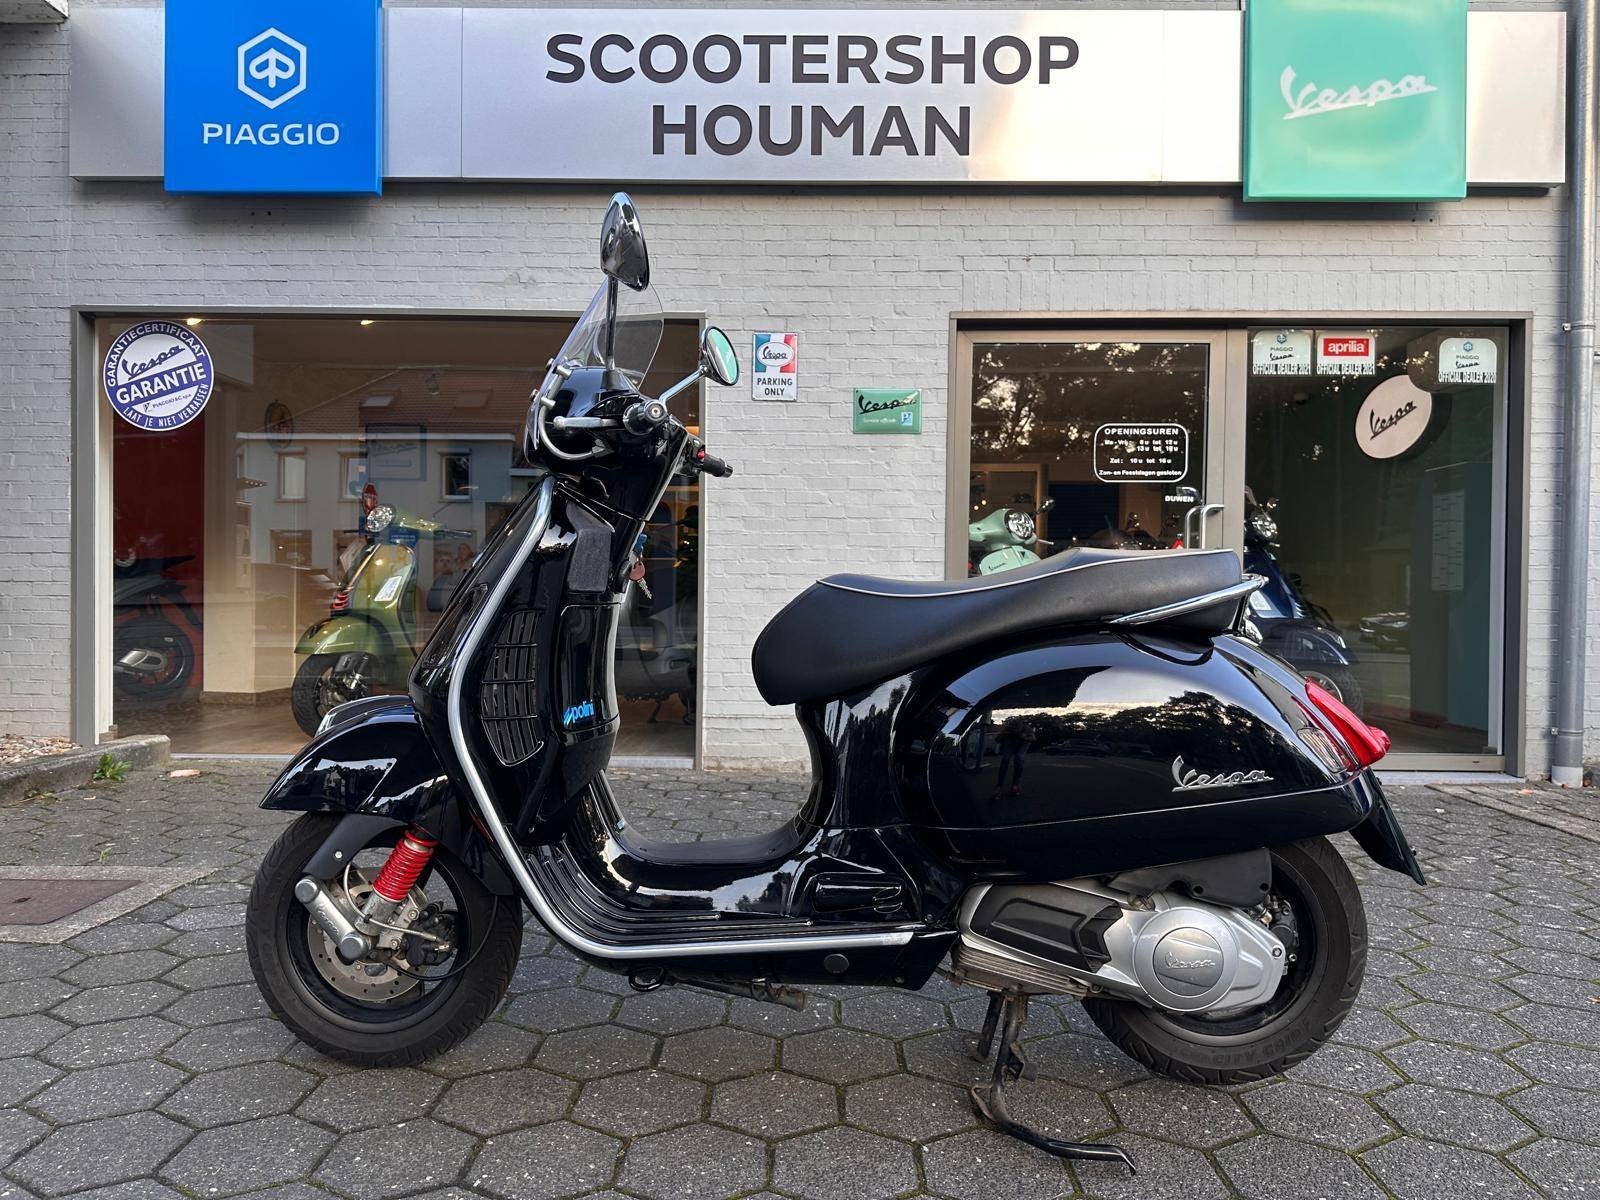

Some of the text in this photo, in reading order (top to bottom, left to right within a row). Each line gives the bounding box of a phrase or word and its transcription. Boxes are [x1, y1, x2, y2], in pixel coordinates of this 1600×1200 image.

[546, 33, 1079, 85] SCOOTERSHOP
[1280, 65, 1438, 120] Vespa
[202, 122, 340, 145] PIAGGIO
[652, 104, 970, 157] HOUMAN
[107, 323, 205, 387] GARANTIECERTIFICAAT
[121, 345, 186, 381] Vespa
[762, 346, 788, 361] Vespa
[1327, 340, 1365, 354] aprilia
[116, 363, 206, 404] GARANTIE
[757, 377, 793, 386] PARKING
[764, 388, 785, 396] ONLY
[123, 407, 142, 422] LAAT
[144, 417, 154, 428] JE
[158, 417, 177, 427] NIET
[1370, 400, 1418, 440] Vespa
[1171, 755, 1274, 792] Vespa
[1164, 951, 1216, 970] Vespa
